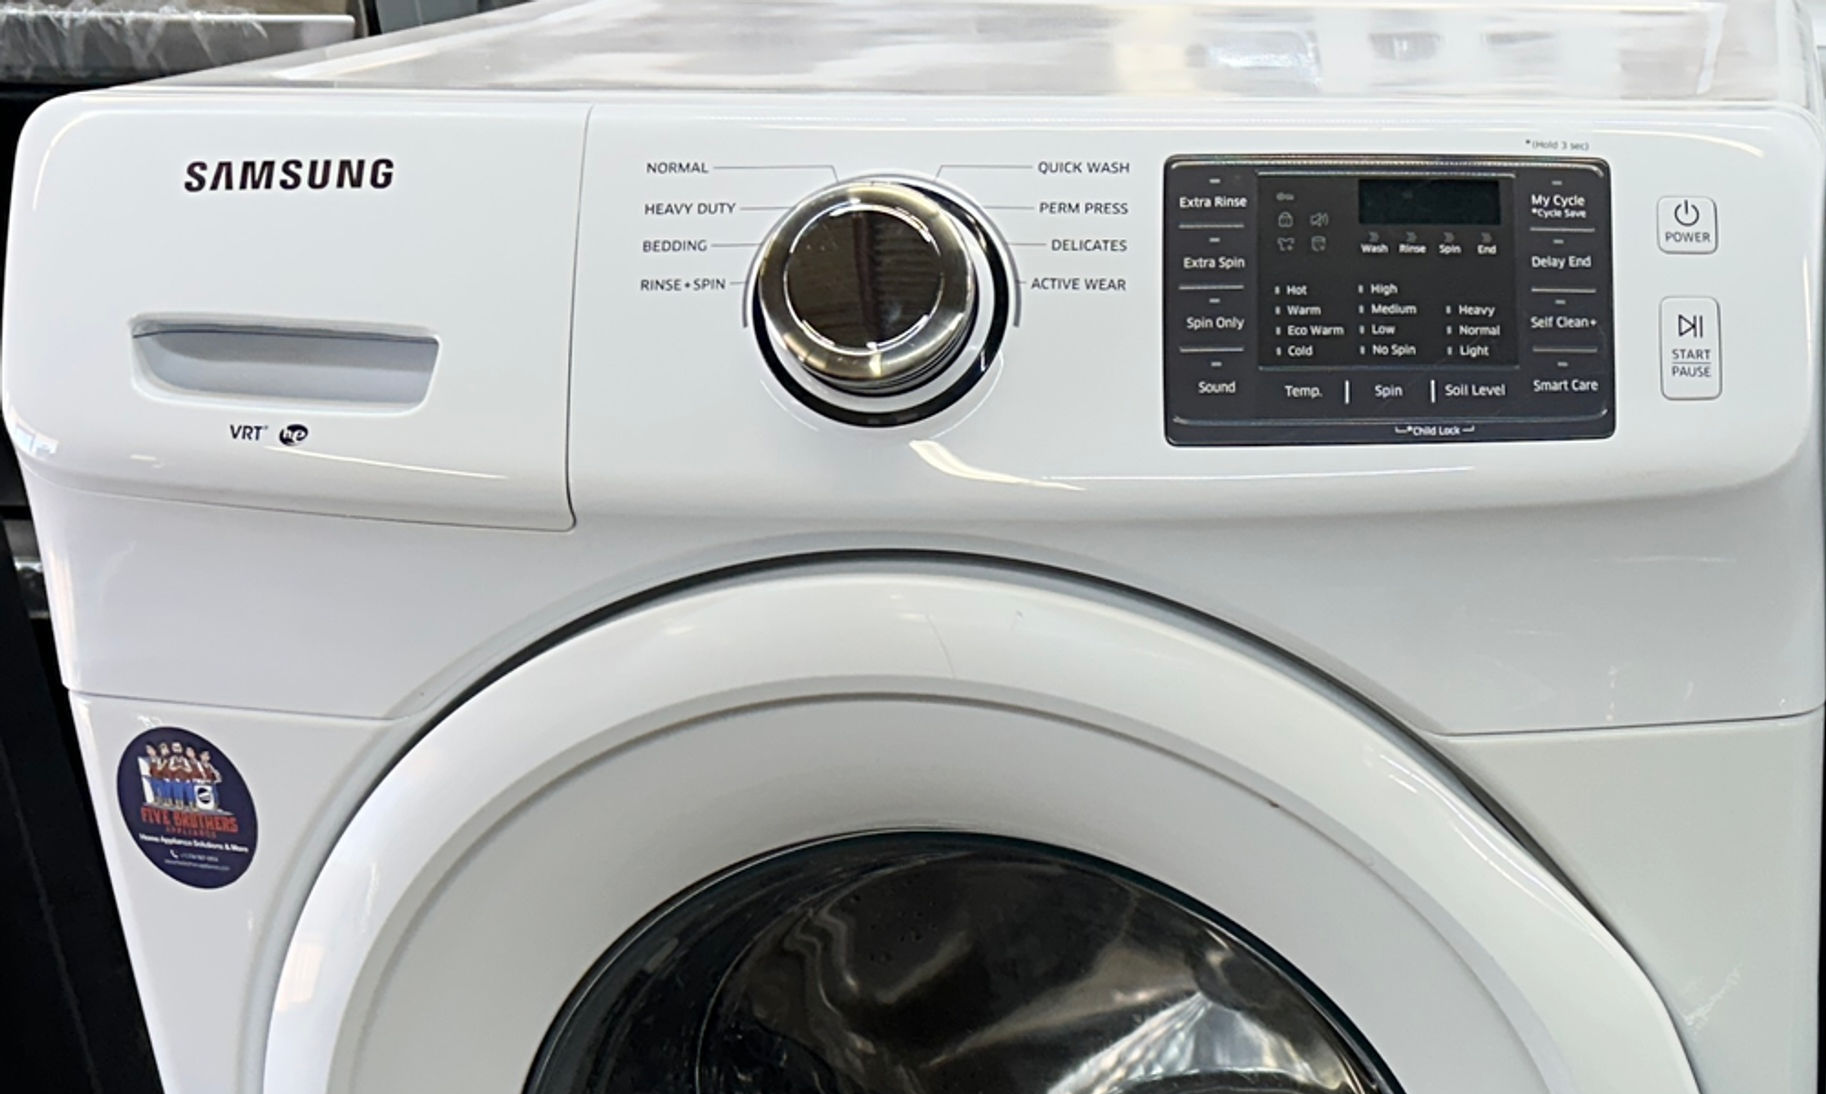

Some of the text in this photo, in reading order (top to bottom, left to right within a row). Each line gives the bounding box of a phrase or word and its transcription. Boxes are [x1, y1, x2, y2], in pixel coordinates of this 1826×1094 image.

[646, 162, 709, 174] NORMAL
[1038, 161, 1130, 175] QUICK WASH
[184, 158, 394, 192] SAMSUNG
[1179, 196, 1248, 208] Extra Rinse
[1531, 194, 1586, 208] My Cycle
[644, 202, 736, 215] HEAVY DUTY
[1039, 202, 1129, 215] PERM PRESS
[1564, 208, 1587, 218] Save
[1665, 232, 1710, 243] POWER
[642, 240, 708, 252] BEDDING
[1051, 239, 1128, 251] DELICATES
[1360, 243, 1389, 254] Wash
[1399, 244, 1427, 254] Rinse
[1439, 244, 1461, 255] Spin
[1477, 245, 1497, 255] End
[1183, 257, 1246, 270] Extra Spin
[1531, 255, 1592, 269] Delay End
[1031, 277, 1127, 291] ACTIVE WEAR
[1370, 284, 1398, 296] High
[1286, 285, 1307, 296] Hot
[1287, 305, 1321, 315] Warm
[1371, 304, 1417, 315] Medium
[1459, 305, 1495, 317] Heavy
[1186, 316, 1245, 331] Spin Only
[1530, 316, 1553, 329] Self
[1287, 325, 1345, 336] Eco Warm
[1371, 325, 1395, 335] Low
[1459, 325, 1500, 336] Normal
[1287, 345, 1313, 357] Cold
[1372, 345, 1416, 357] No Spin
[1459, 346, 1490, 357] Light
[1672, 349, 1710, 360] START
[1672, 366, 1711, 378] PAUSE
[1198, 381, 1236, 394] Sound
[1284, 385, 1322, 398] Temp.
[1374, 384, 1403, 398] Spin
[1445, 384, 1506, 397] Soil Level
[1533, 379, 1599, 392] Smart Care
[1439, 425, 1460, 436] Lock
[141, 807, 238, 833] FIVE BROTHERS
